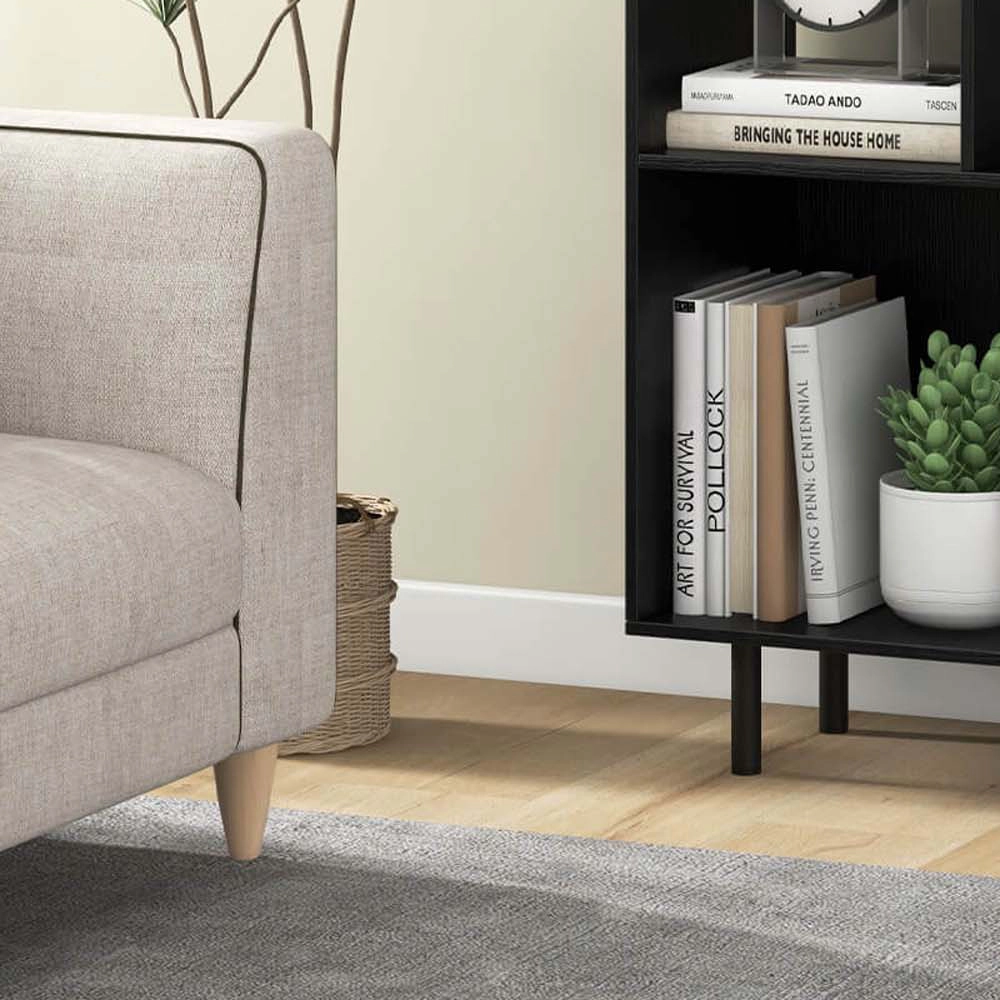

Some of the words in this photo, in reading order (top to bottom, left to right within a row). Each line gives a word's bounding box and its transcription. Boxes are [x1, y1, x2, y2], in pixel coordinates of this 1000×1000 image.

[784, 93, 825, 107] TADAO
[828, 95, 862, 108] ANDO
[734, 125, 792, 144] BRINGING
[796, 128, 819, 146] THE
[823, 130, 863, 148] HOUSE
[866, 132, 901, 150] HOME
[797, 379, 815, 473] CENTENNIAL
[677, 430, 694, 512] SURVIVAL
[706, 389, 726, 533] POLLOCK
[804, 478, 819, 521] PENN:
[677, 519, 694, 555] FOR
[807, 526, 824, 581] IRVING
[677, 563, 694, 597] ART
